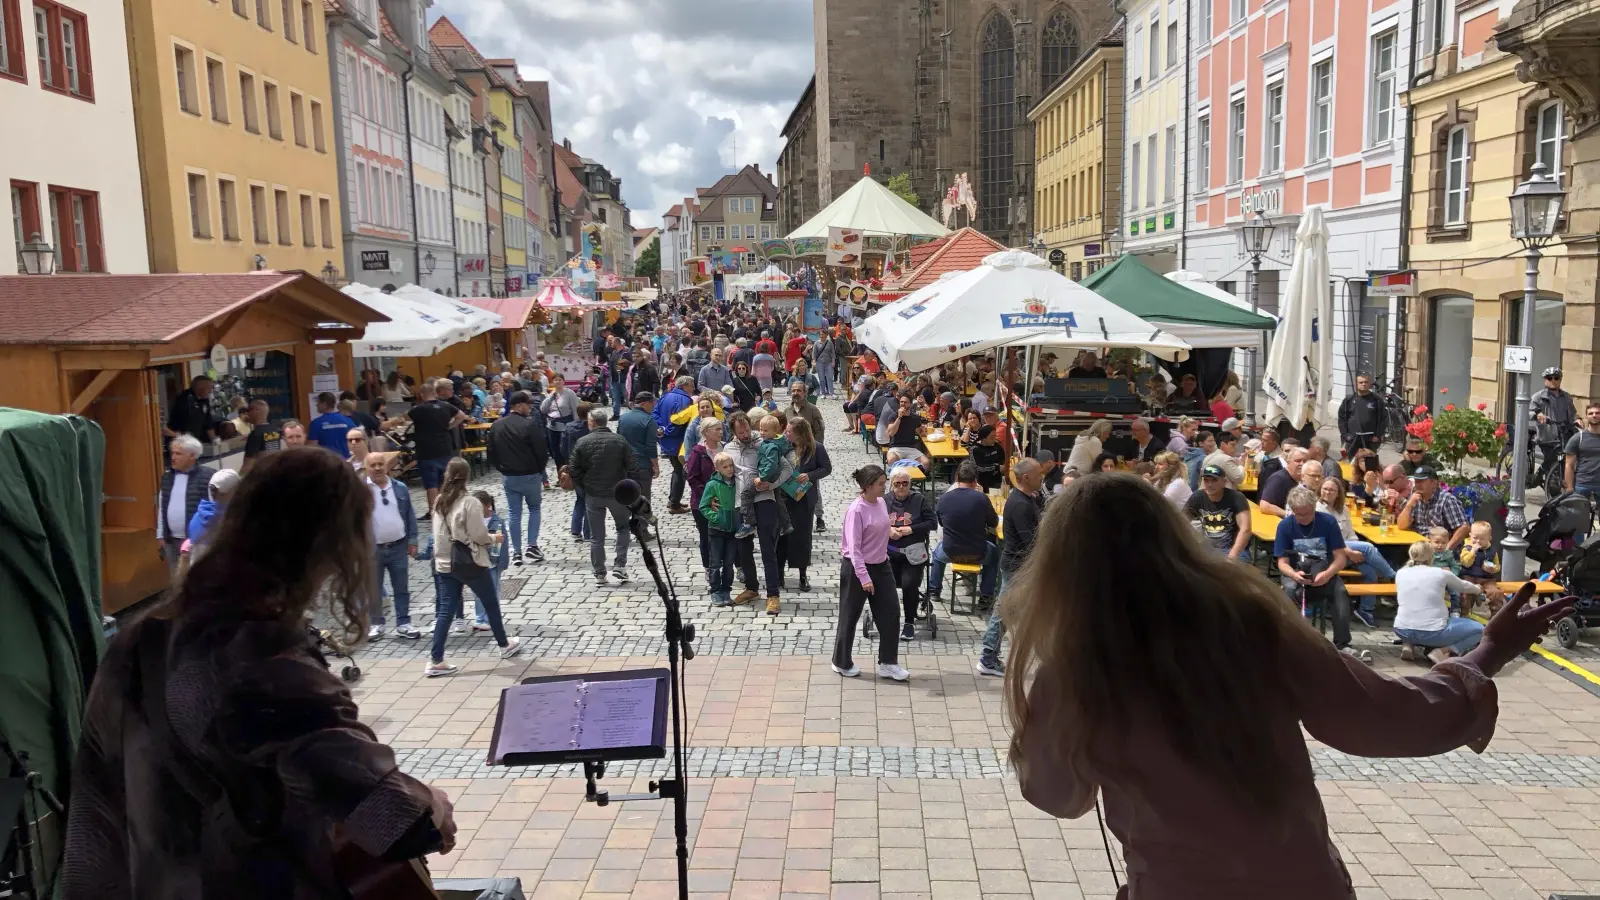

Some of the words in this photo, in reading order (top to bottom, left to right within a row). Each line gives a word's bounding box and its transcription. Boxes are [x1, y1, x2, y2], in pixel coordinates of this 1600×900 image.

[362, 252, 387, 261] MATT
[464, 258, 485, 273] H&M
[1008, 315, 1070, 326] Tucher
[376, 344, 404, 352] Tucher
